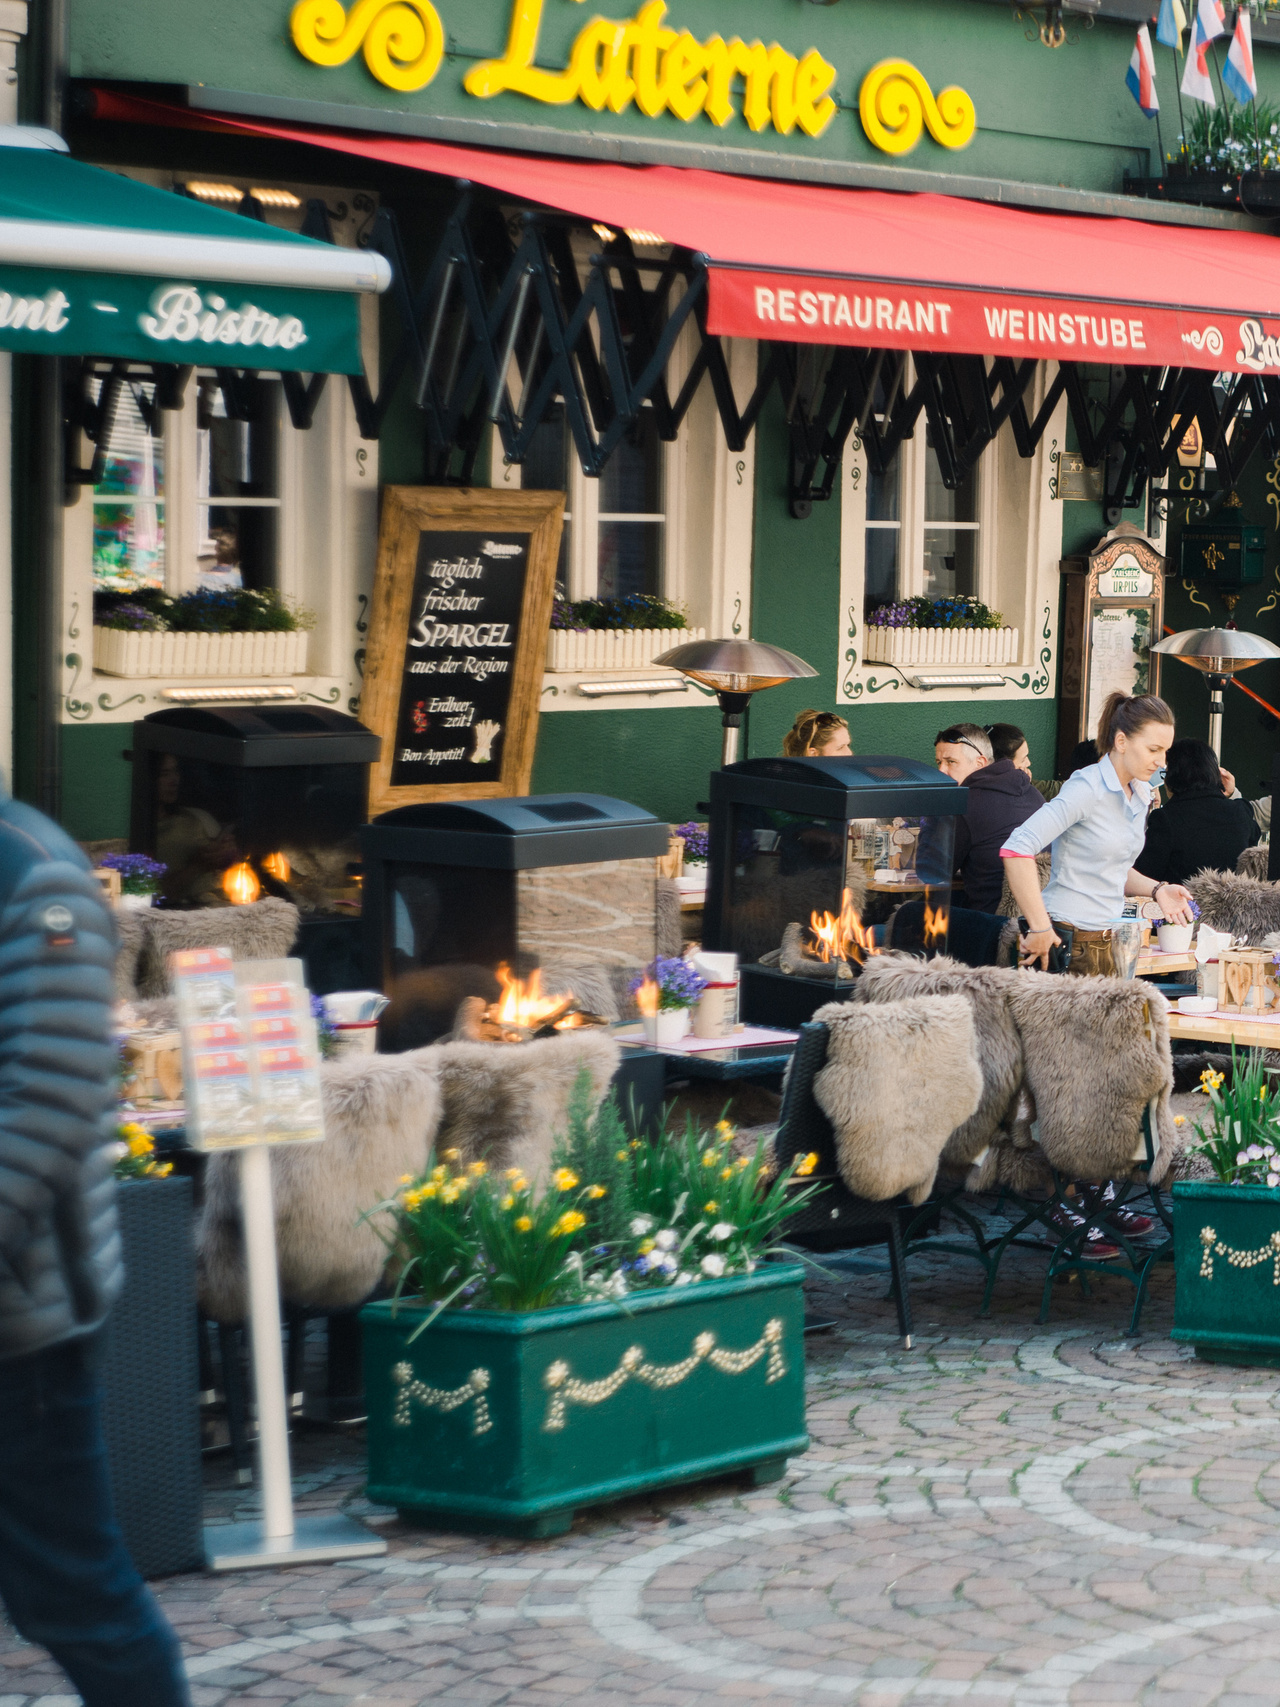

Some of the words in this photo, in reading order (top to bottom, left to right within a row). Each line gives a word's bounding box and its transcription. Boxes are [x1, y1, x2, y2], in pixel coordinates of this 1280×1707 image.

[143, 286, 307, 349] Bistro
[755, 287, 951, 334] RESTAURANT
[984, 307, 1146, 349] WEINSTUBE
[430, 557, 483, 588] täglich
[422, 588, 484, 616] frischer
[410, 615, 512, 648] SPARGEL
[411, 660, 436, 674] aus
[440, 656, 461, 674] der
[464, 655, 508, 682] Region
[444, 708, 474, 728] zeit!
[401, 749, 421, 762] Bon
